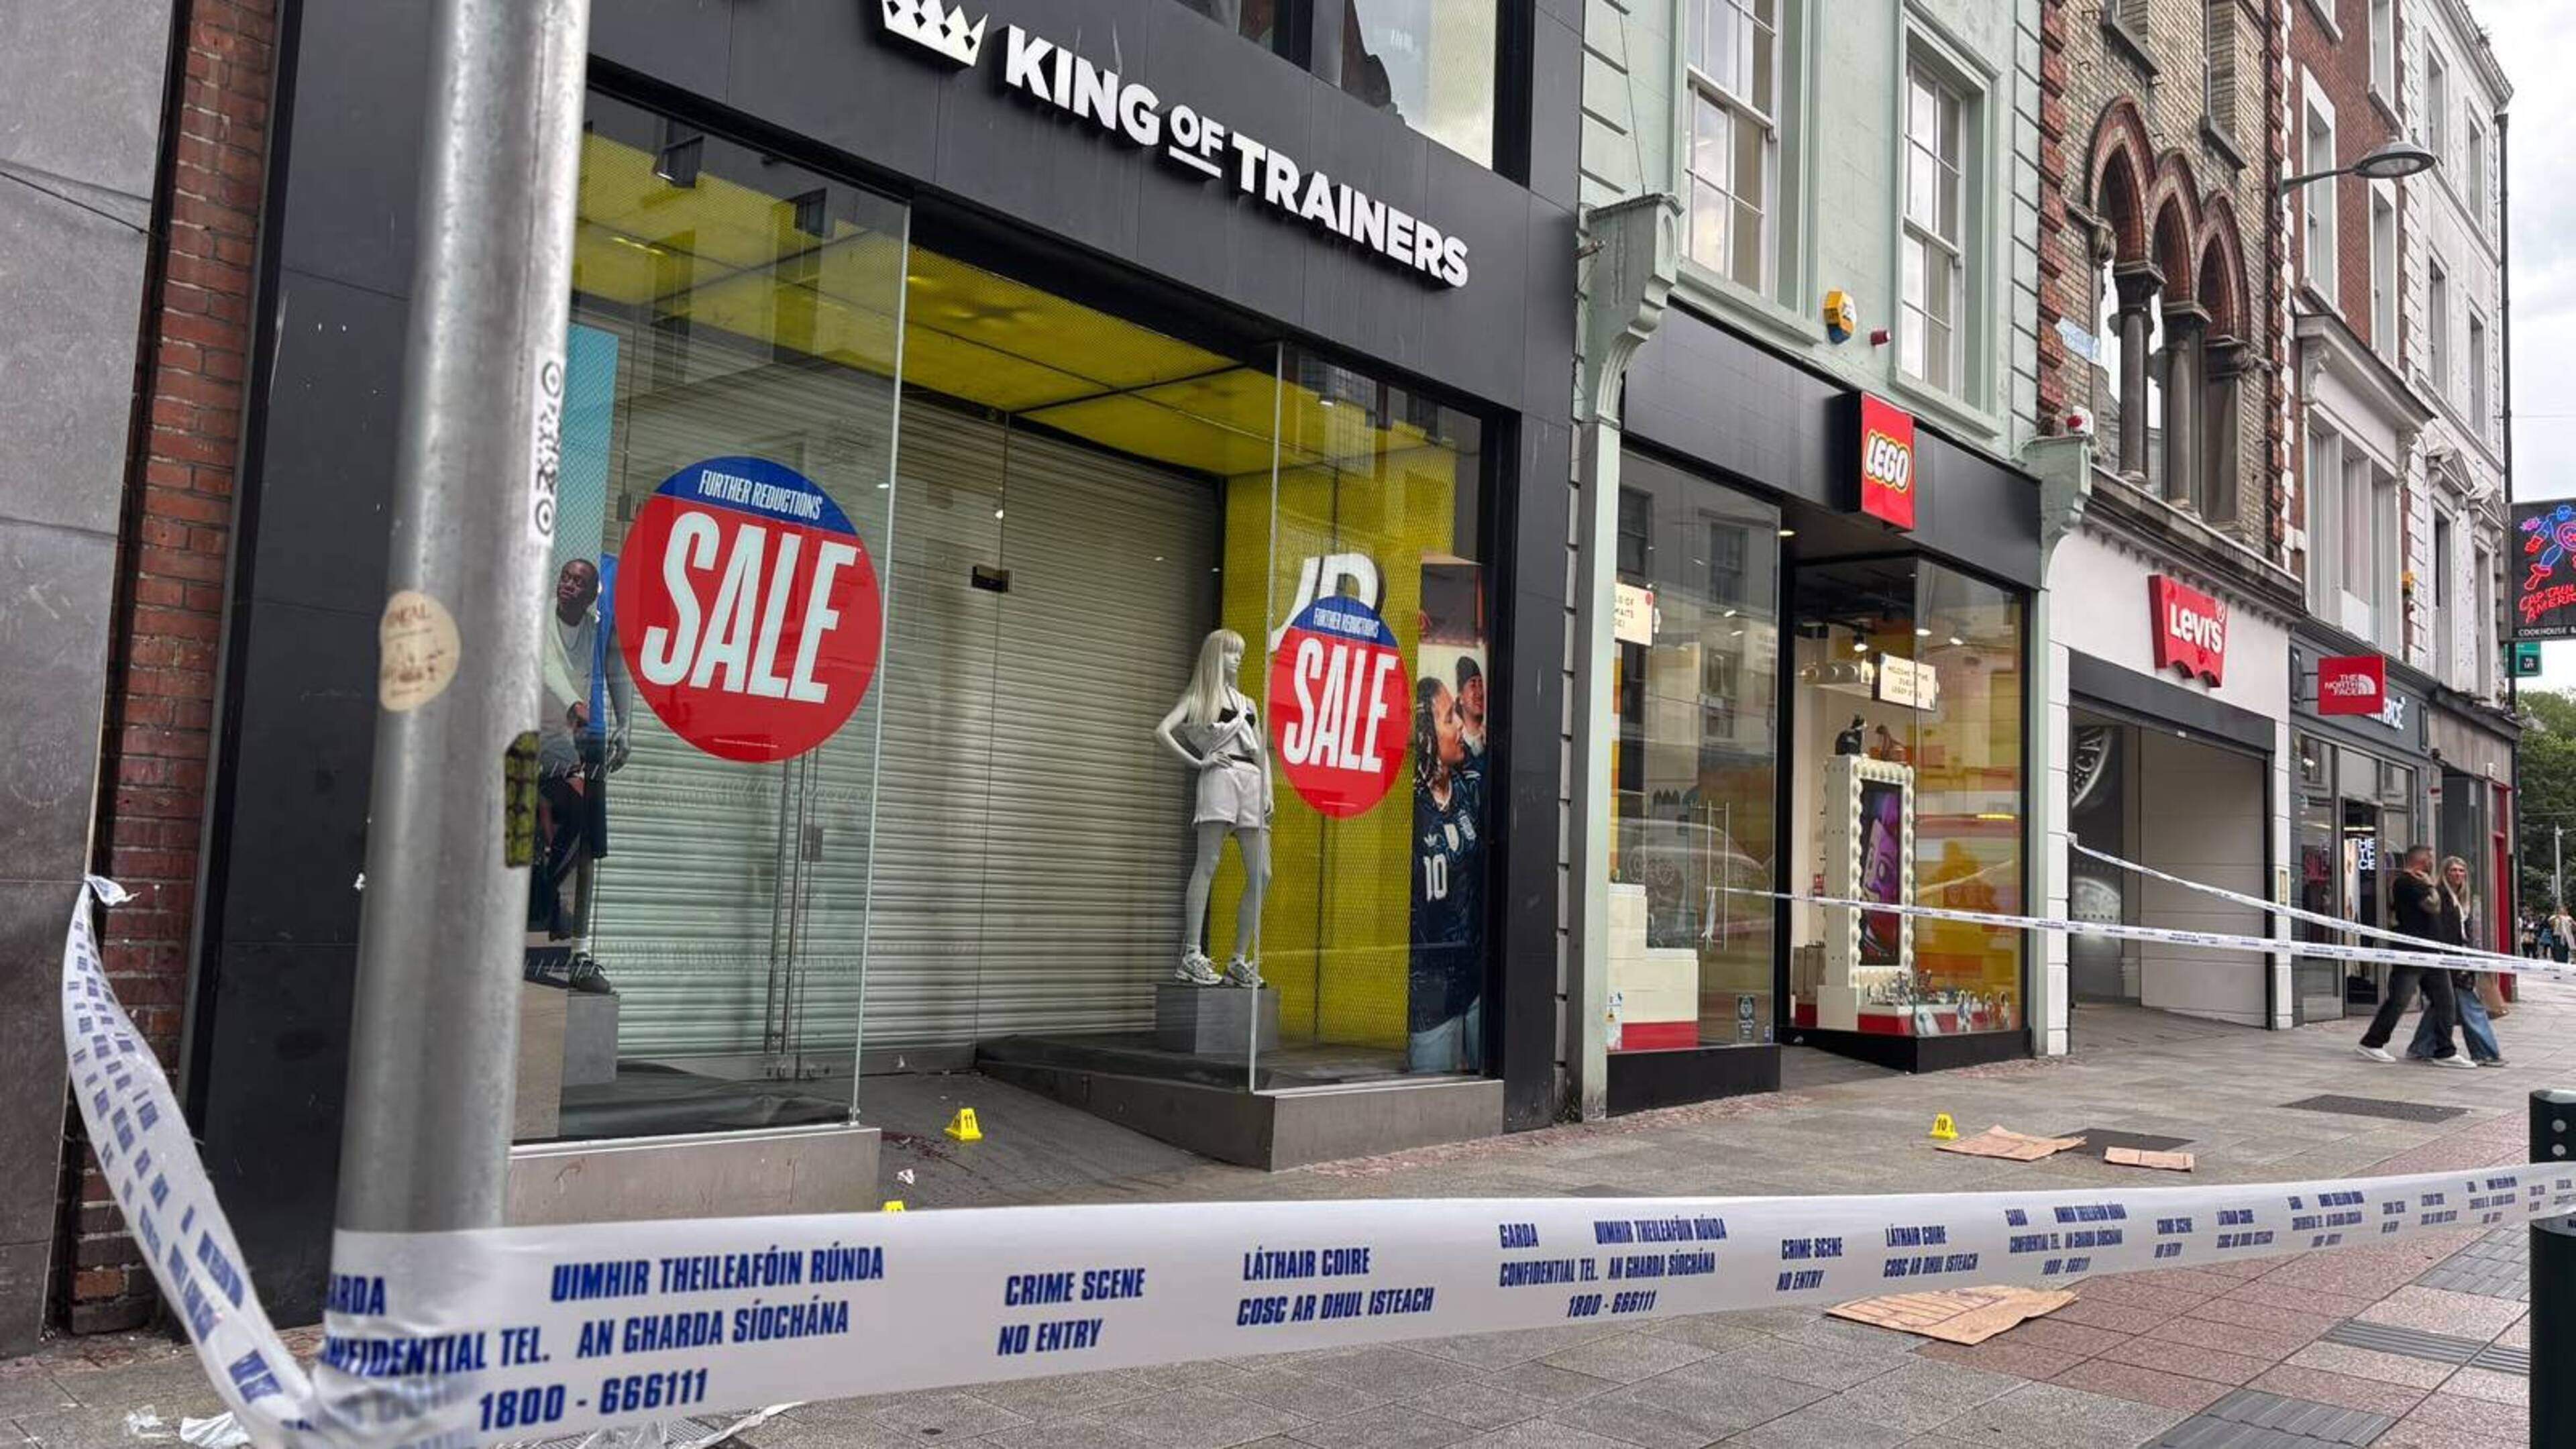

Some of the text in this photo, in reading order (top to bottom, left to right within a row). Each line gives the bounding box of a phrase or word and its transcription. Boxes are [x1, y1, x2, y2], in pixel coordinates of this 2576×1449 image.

[1006, 25, 1469, 289] KING OF TRAINERS
[1866, 431, 1910, 490] LEGO
[698, 470, 823, 521] FURTHER REDUCTIONS
[640, 511, 858, 704] SALE
[1283, 637, 1399, 773] SALE
[1423, 853, 1448, 902] 10
[964, 1114, 973, 1129] 11
[1937, 1118, 1947, 1131] 10
[1499, 1223, 1540, 1248] GARDA
[1782, 1237, 1843, 1260] CRIME SCENE
[551, 1259, 650, 1303] UIMHIR
[659, 1245, 804, 1295] THEILEAFÓIN
[809, 1241, 884, 1284] RÚNDA
[1243, 1245, 1371, 1281] LÁTHAIR COIRE
[1499, 1258, 1576, 1287] CONFIDENTIAL
[1578, 1257, 1599, 1282] TEL.
[1607, 1256, 1624, 1280] AN
[1625, 1254, 1665, 1279] GHARDA
[1792, 1270, 1825, 1290] ENTRY
[1004, 1268, 1146, 1307] CRIME SCENE
[1236, 1287, 1435, 1327] COSC AR DHUL ISTEACH
[1567, 1293, 1603, 1318] 1800
[1611, 1289, 1658, 1314] 666111
[500, 1326, 551, 1367] TEL.
[576, 1320, 616, 1360] AN
[621, 1310, 724, 1354] GHARDA
[731, 1295, 849, 1343] SÍOCHÁNA
[997, 1318, 1104, 1356] NO ENTRY
[478, 1384, 566, 1432] 1800
[598, 1368, 708, 1415] 666111
